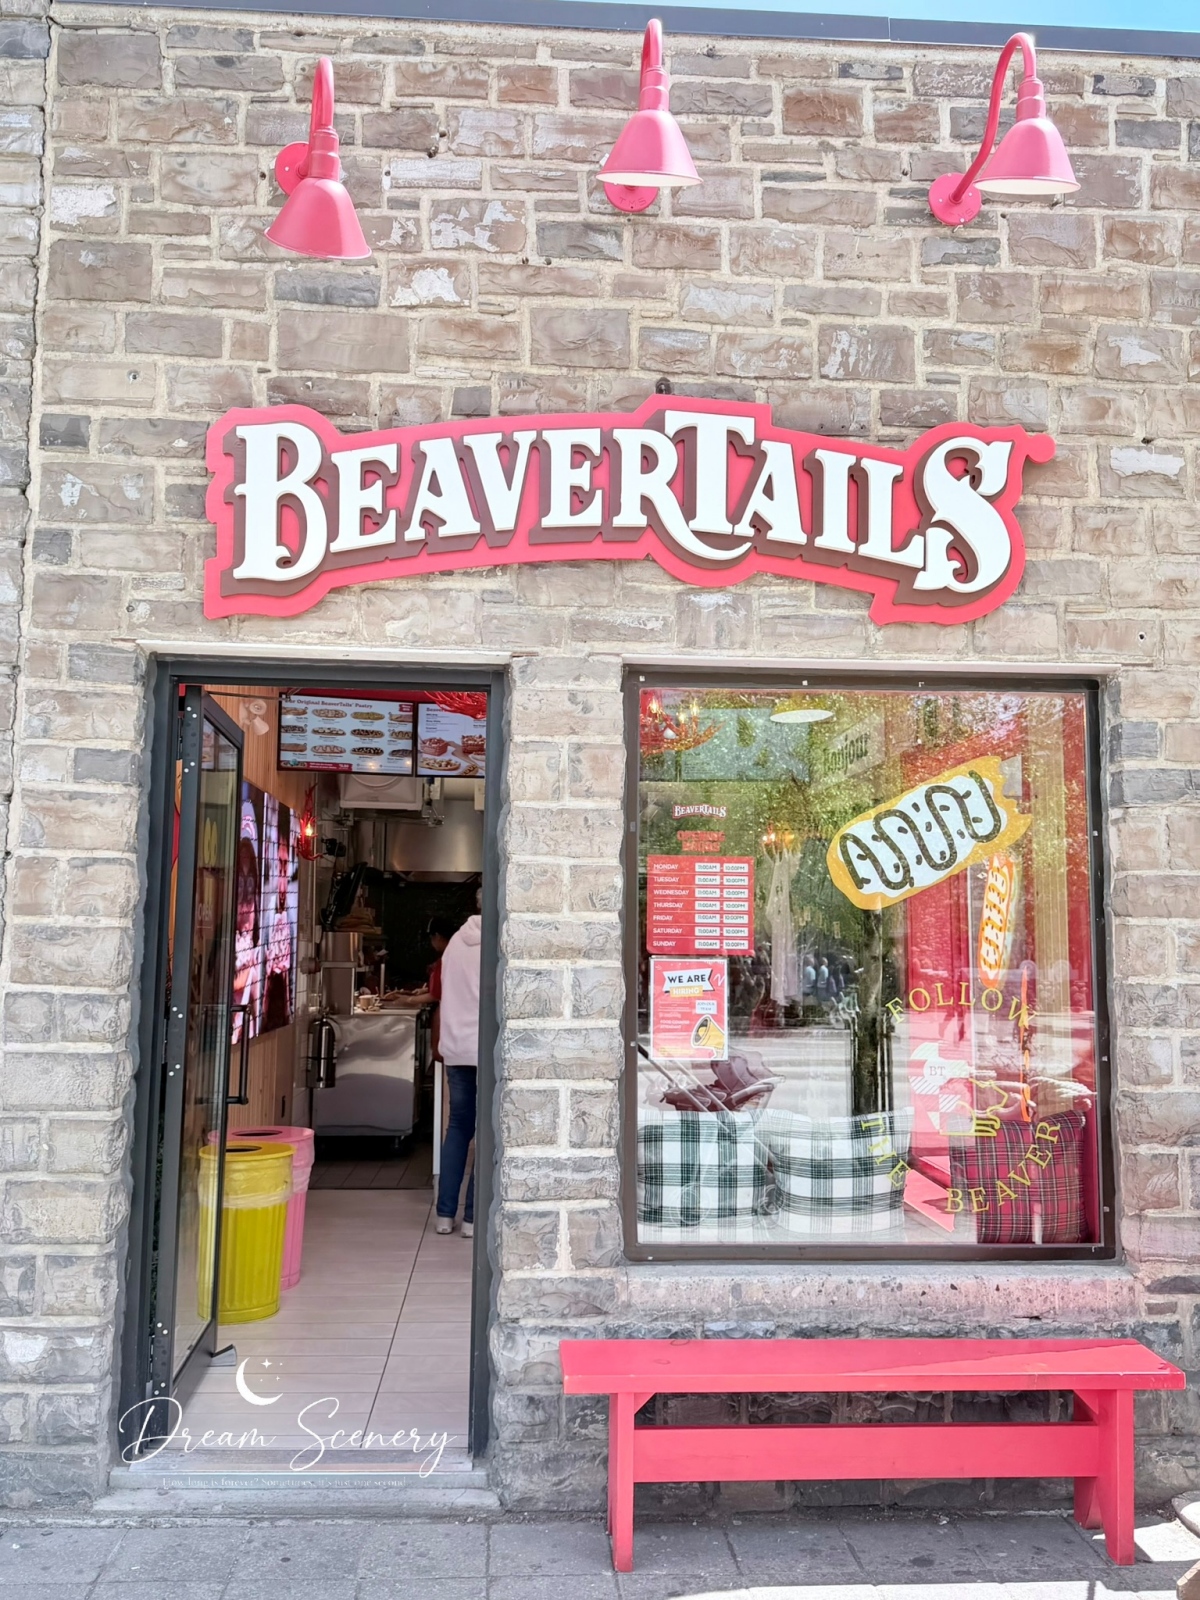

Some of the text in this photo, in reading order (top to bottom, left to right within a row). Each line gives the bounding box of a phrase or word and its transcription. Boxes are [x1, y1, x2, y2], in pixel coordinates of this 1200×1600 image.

[232, 409, 1013, 593] BEAVERTAILS
[674, 804, 727, 818] BEAVERTAILS
[677, 830, 726, 842] OPENING
[667, 974, 706, 983] WE ARE
[673, 987, 700, 995] HIRING
[885, 981, 1038, 1030] FOLLOW
[929, 1065, 945, 1077] BT
[861, 1113, 1061, 1213] THE BEAVER
